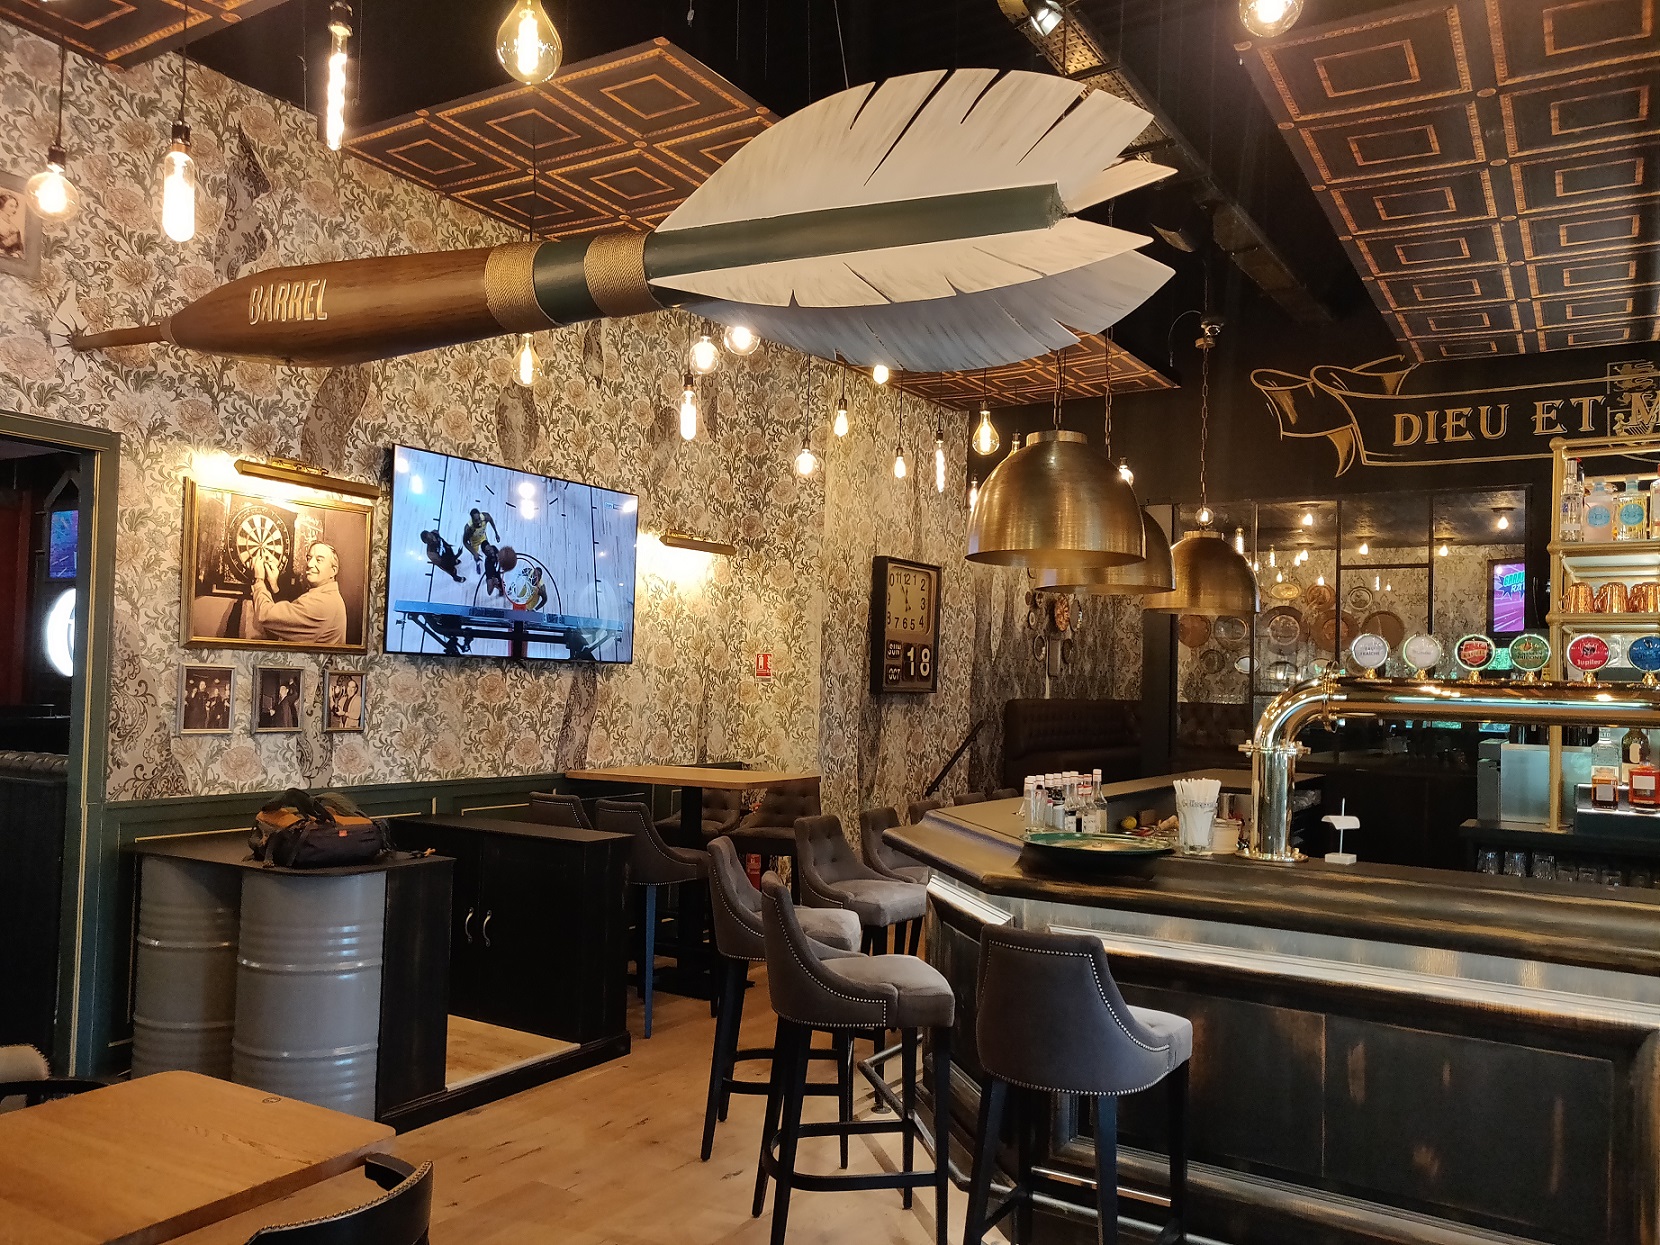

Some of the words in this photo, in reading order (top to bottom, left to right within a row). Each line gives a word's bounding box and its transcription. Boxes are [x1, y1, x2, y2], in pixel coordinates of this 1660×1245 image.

[249, 279, 328, 325] BARREL
[1392, 403, 1510, 447] DIEU
[1530, 395, 1606, 435] ET
[904, 573, 911, 585] 12
[902, 617, 908, 630] 6
[910, 618, 916, 631] 5
